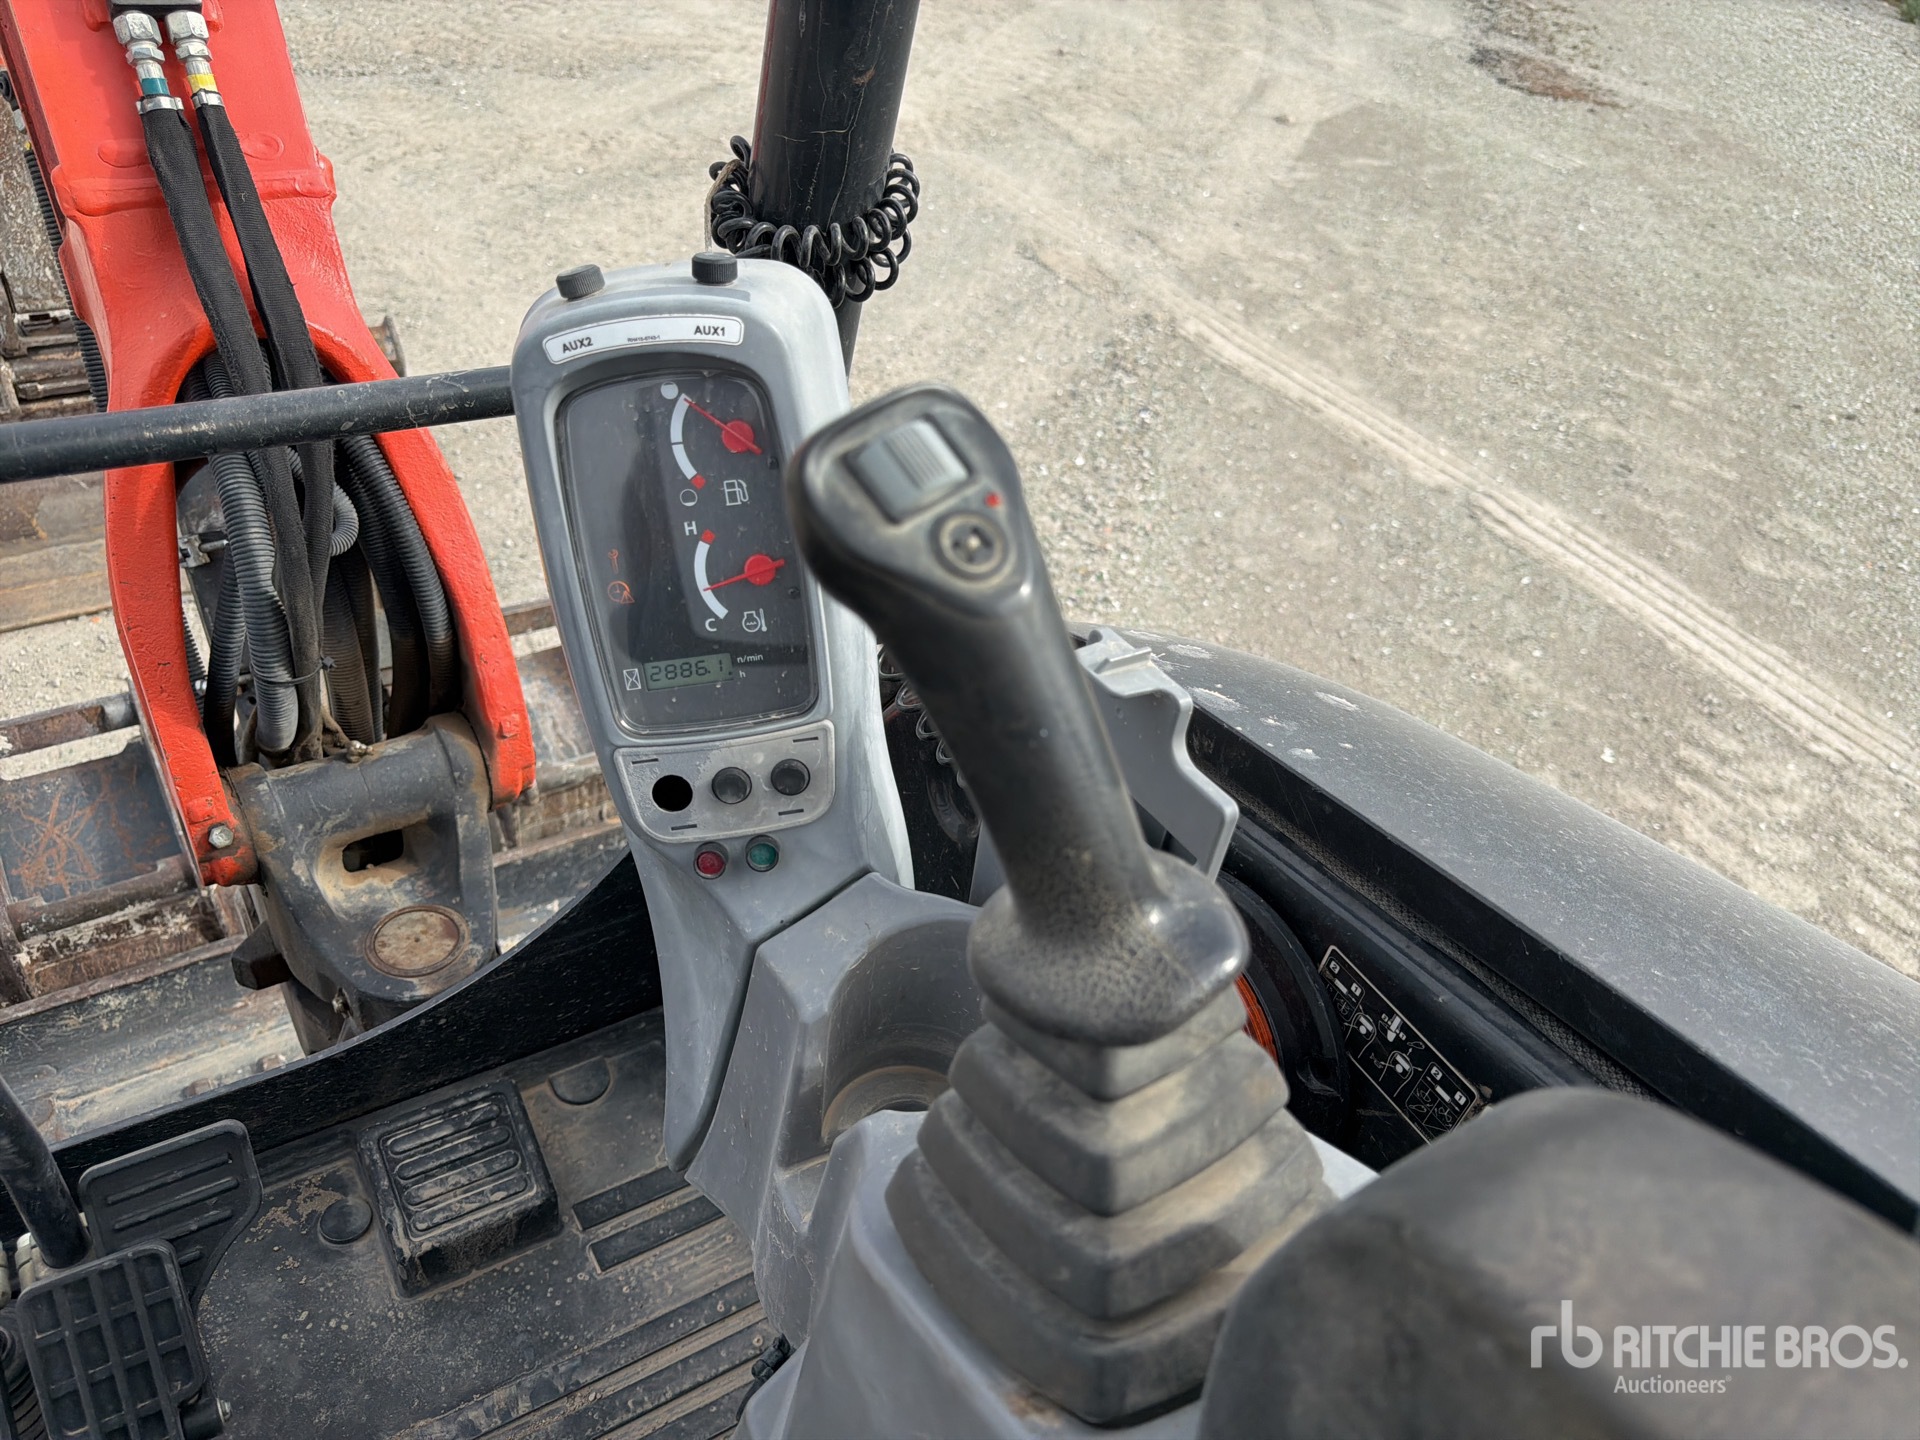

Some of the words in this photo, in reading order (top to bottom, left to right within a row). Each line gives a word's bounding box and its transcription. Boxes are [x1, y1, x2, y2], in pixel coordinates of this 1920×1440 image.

[562, 336, 594, 354] AUX2
[693, 325, 726, 337] AUX1
[683, 520, 698, 537] H
[704, 617, 718, 632] C
[736, 653, 764, 664] n/min
[738, 669, 747, 679] h
